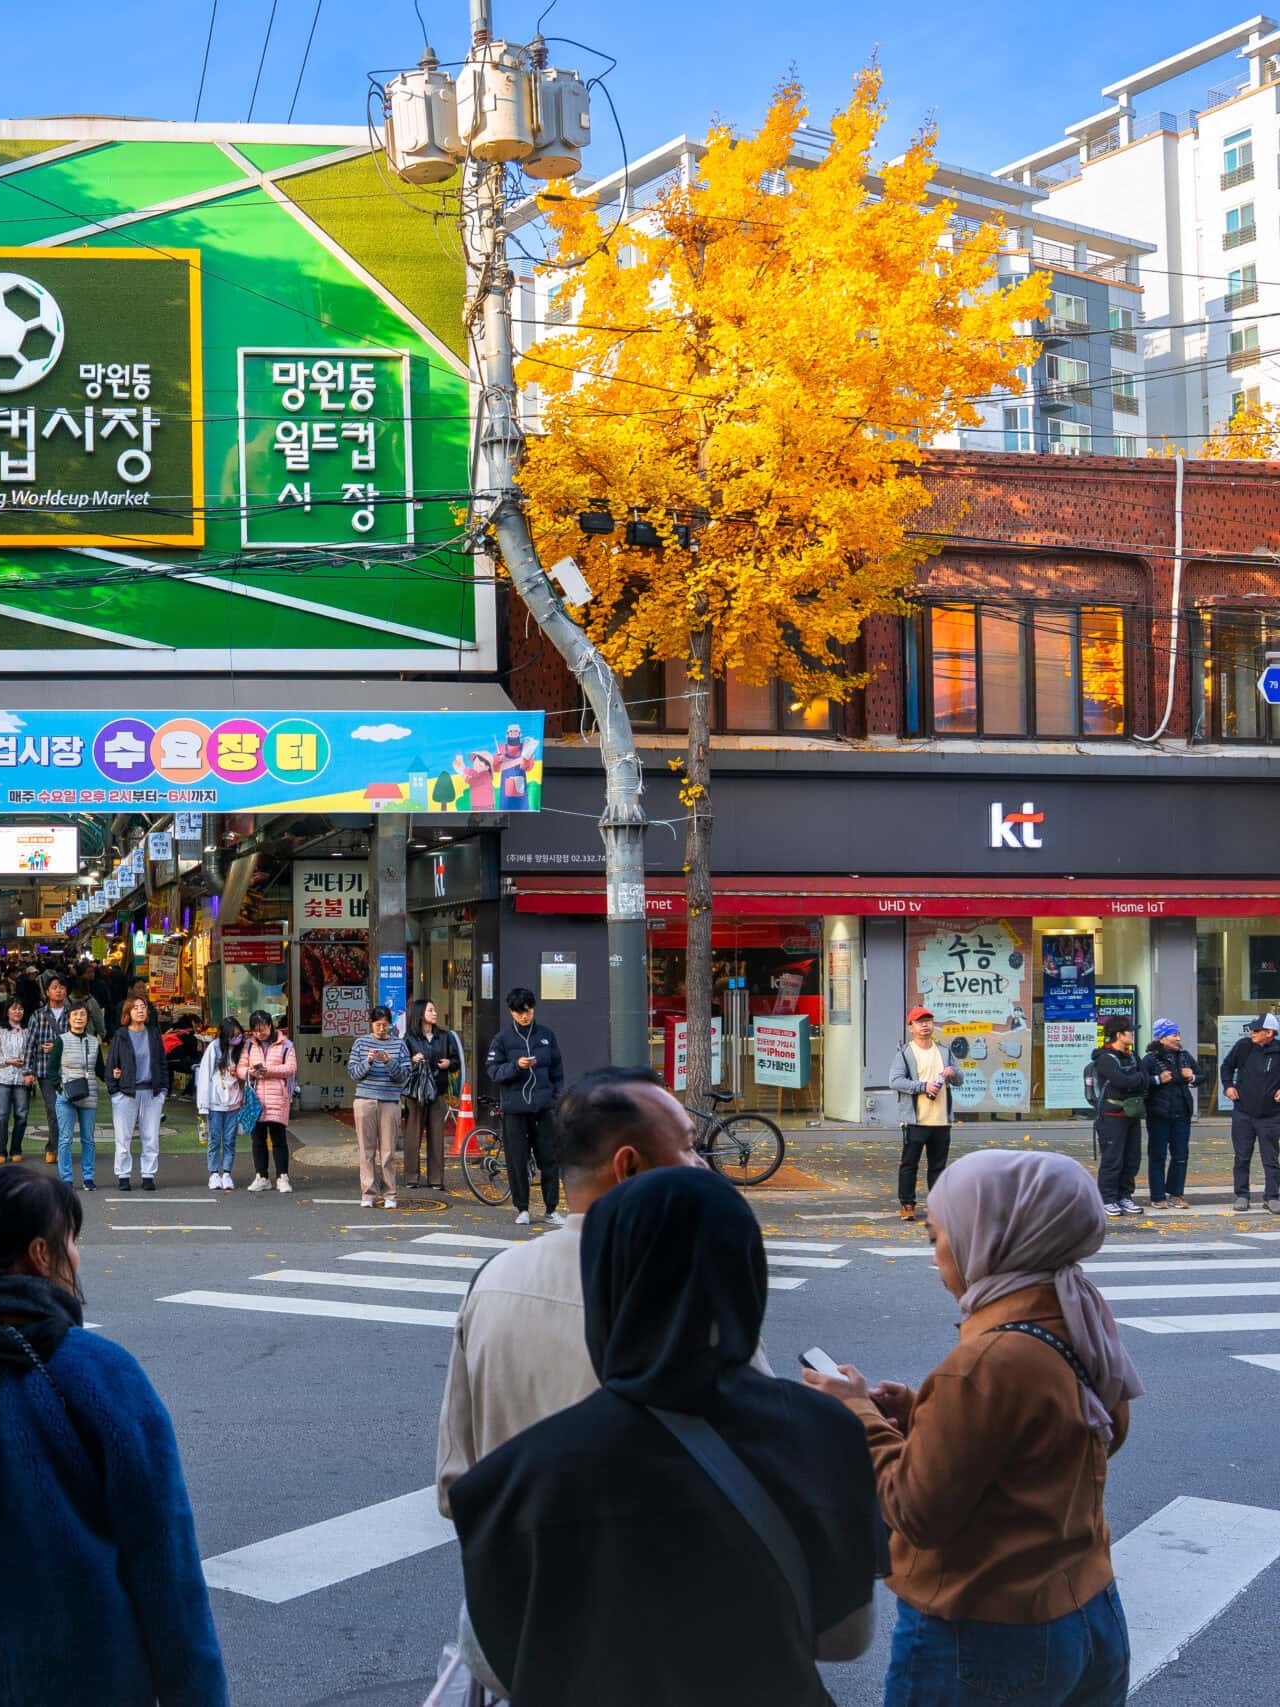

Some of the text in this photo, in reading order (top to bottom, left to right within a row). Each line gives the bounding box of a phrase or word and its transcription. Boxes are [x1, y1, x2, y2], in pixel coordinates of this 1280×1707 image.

[79, 363, 151, 399] 망원동
[272, 361, 376, 412] 망원동
[273, 422, 376, 471] 월드컵
[11, 489, 88, 508] Worldcup
[93, 489, 150, 506] Market
[104, 731, 317, 772] 수요장터
[8, 789, 217, 803] 매주 수요일 오후 2시부터~6시까지
[991, 802, 1044, 848] kt
[303, 872, 363, 893] 켄터키
[303, 898, 342, 918] 숯불
[646, 900, 673, 911] rnet
[878, 900, 922, 912] UHD tv
[1111, 902, 1165, 913] Home IoT
[947, 934, 996, 972] 수능
[942, 971, 1004, 995] Event
[757, 1058, 797, 1074] 추가할인!
